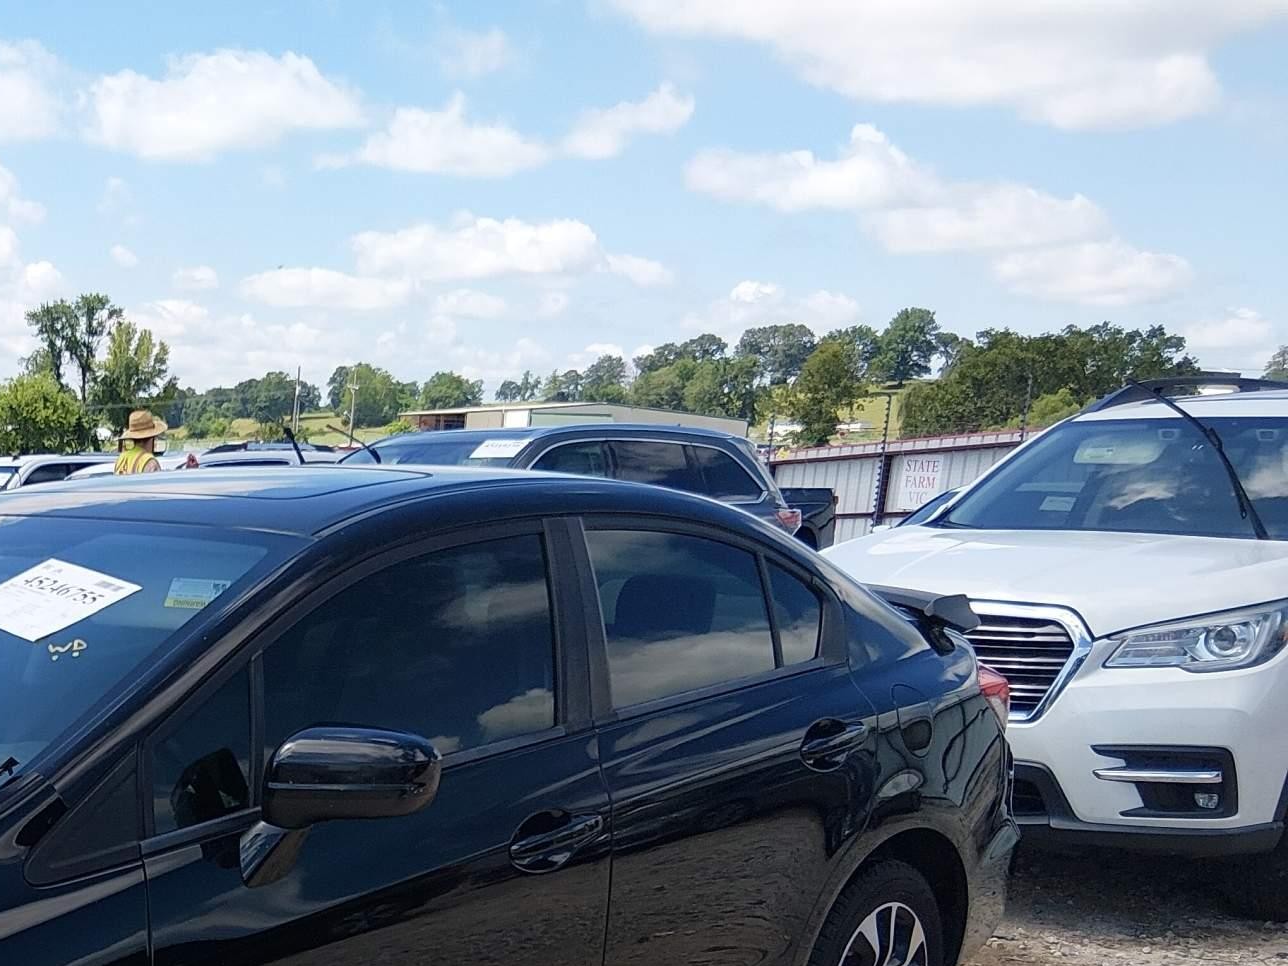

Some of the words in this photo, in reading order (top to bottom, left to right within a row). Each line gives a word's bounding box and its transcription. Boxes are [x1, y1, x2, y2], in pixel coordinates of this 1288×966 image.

[905, 459, 940, 473] STATE
[905, 475, 937, 489] FARM
[24, 575, 105, 605] 45246755
